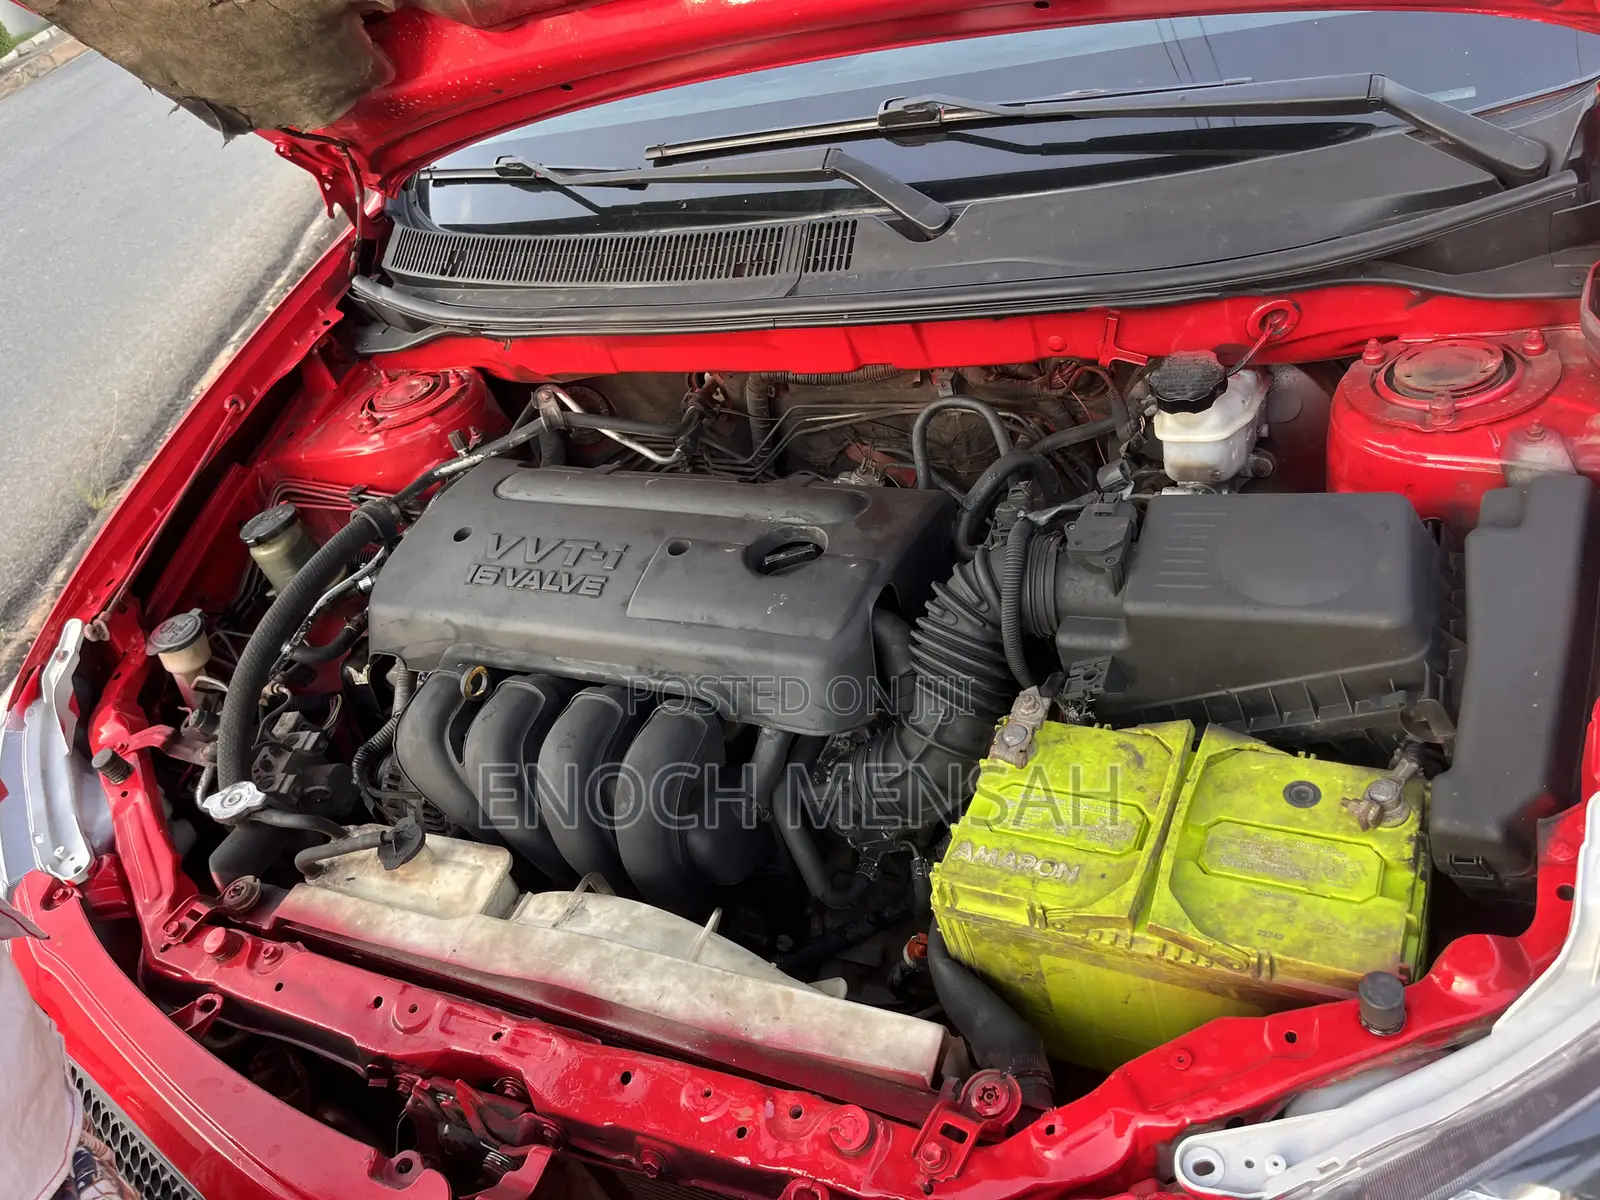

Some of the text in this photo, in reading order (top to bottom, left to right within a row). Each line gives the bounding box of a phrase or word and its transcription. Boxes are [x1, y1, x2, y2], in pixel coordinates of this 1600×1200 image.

[464, 562, 609, 598] 16 VALVE
[951, 842, 1080, 881] AMARON
